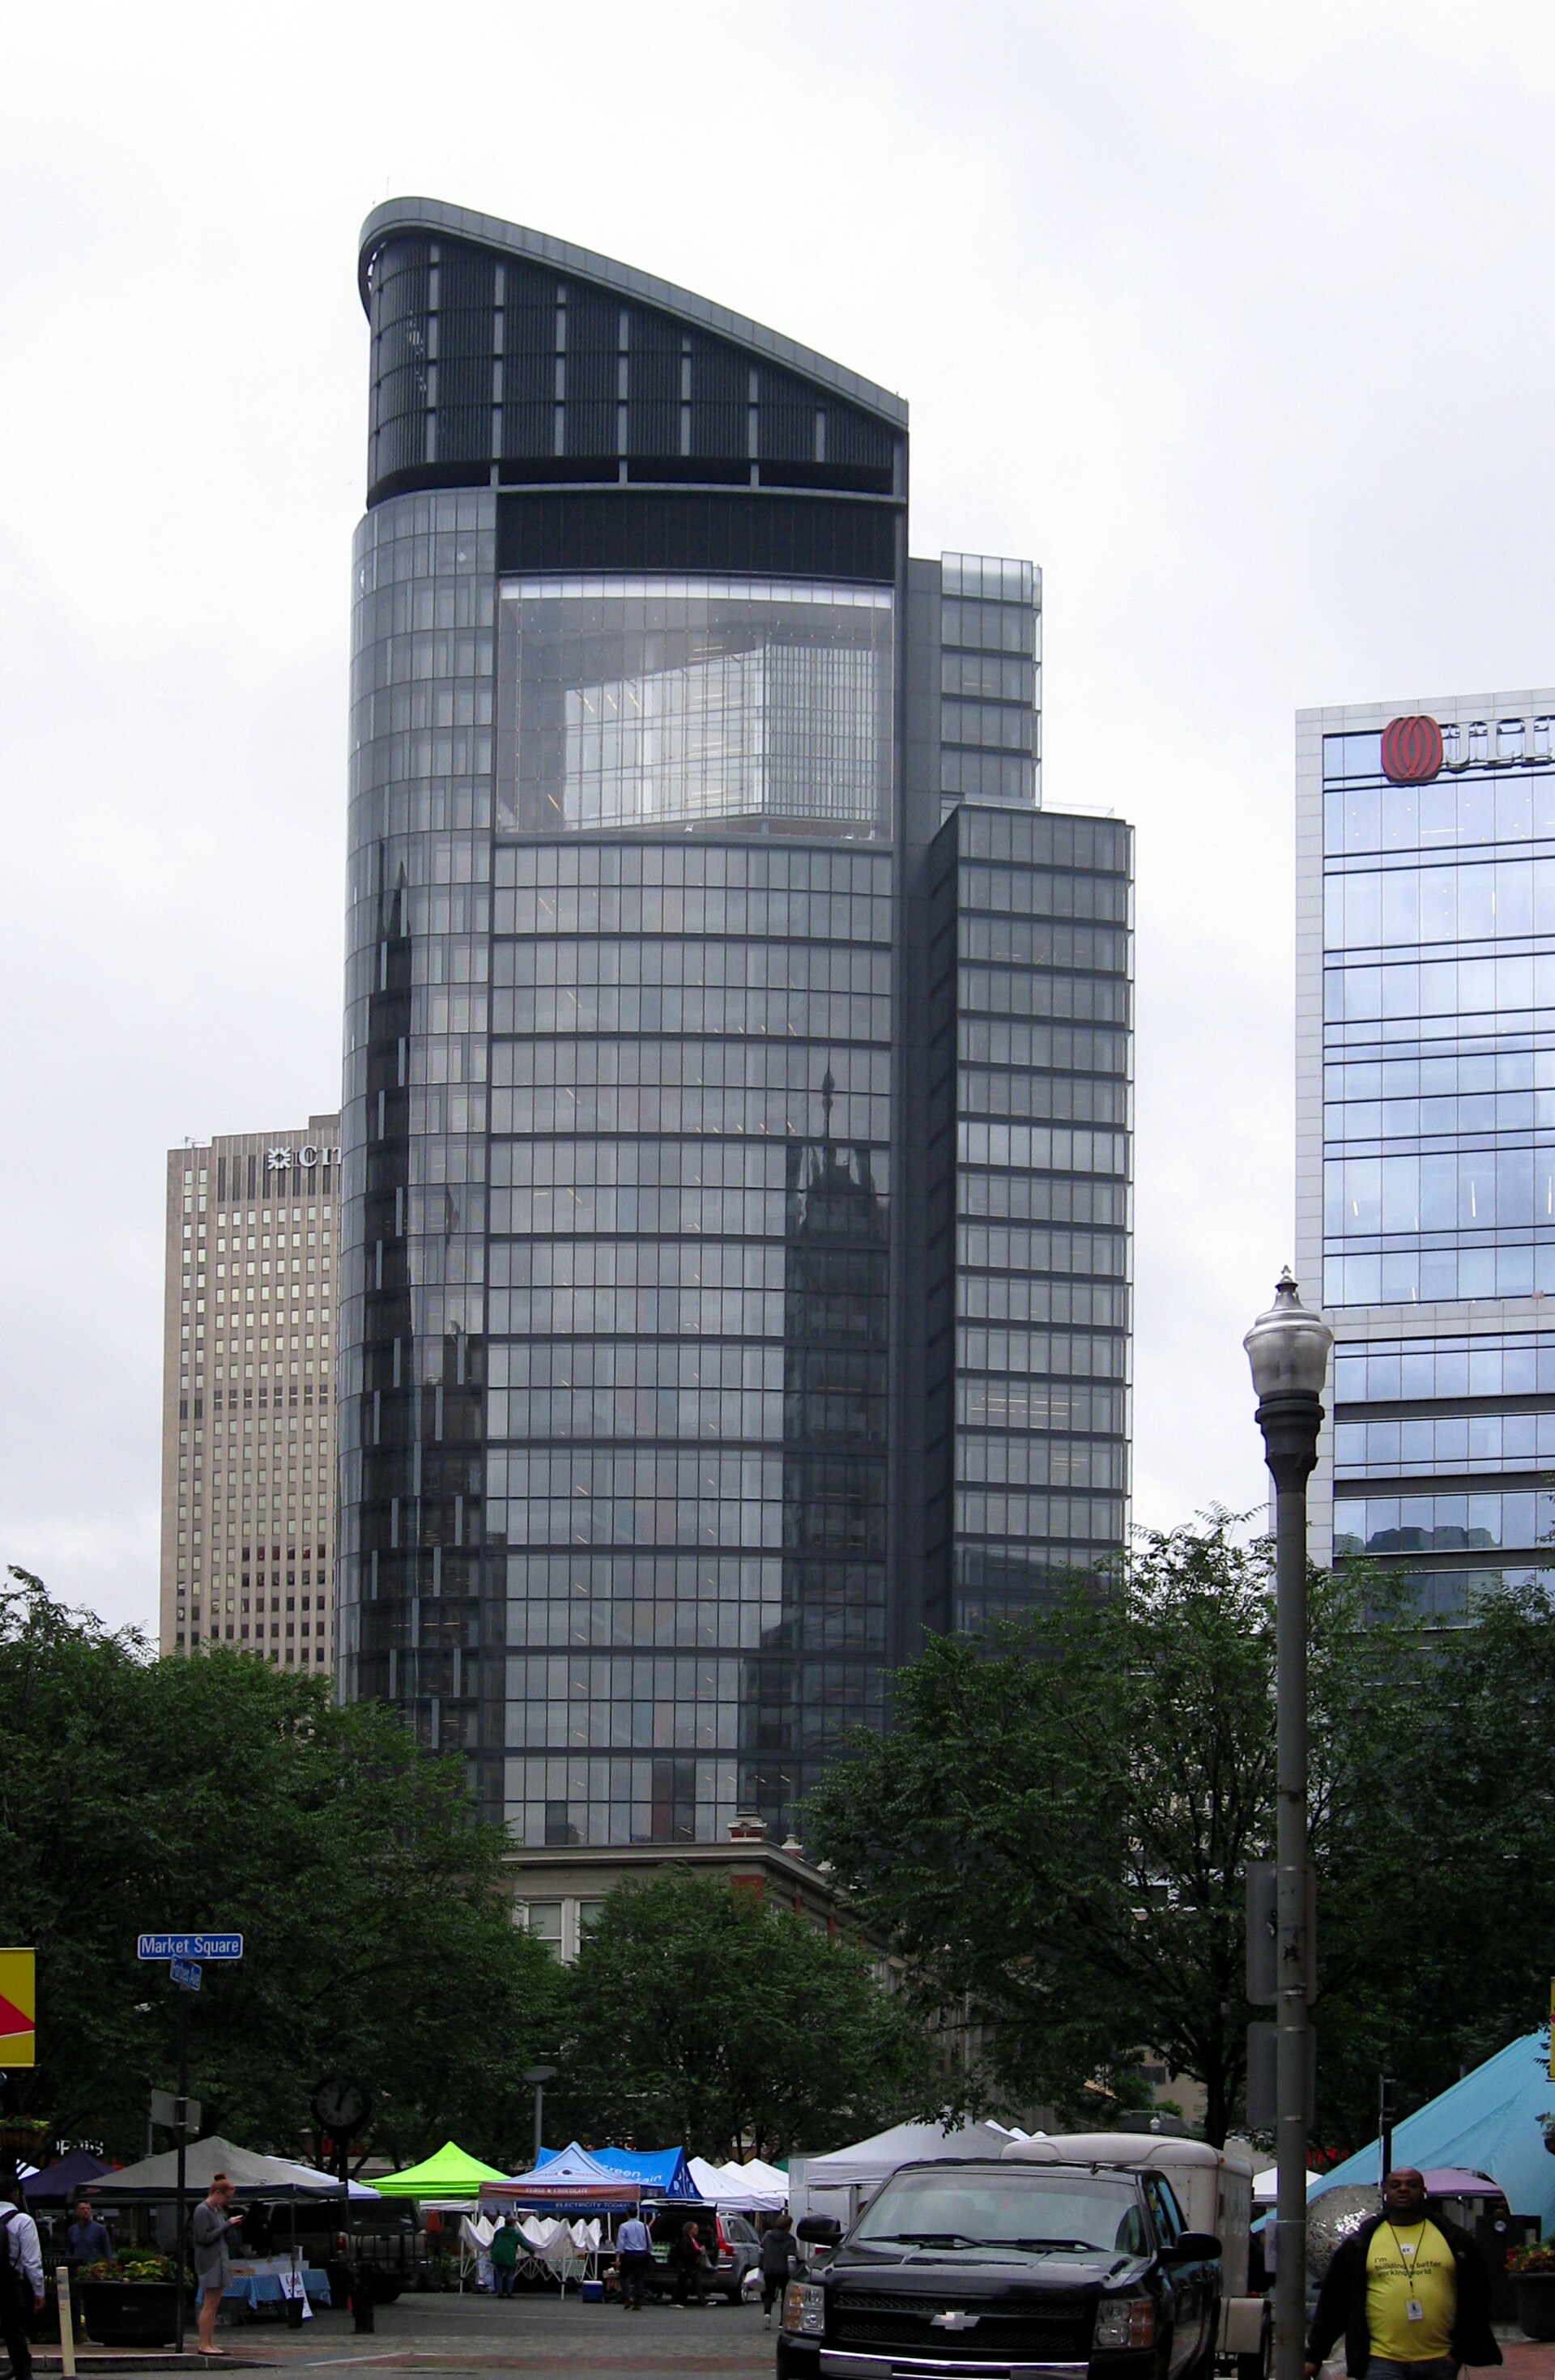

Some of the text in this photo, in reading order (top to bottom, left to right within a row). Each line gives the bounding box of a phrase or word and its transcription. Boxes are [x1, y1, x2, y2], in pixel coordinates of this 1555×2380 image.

[141, 1936, 239, 1956] Market Square
[1374, 2262, 1407, 2271] building
